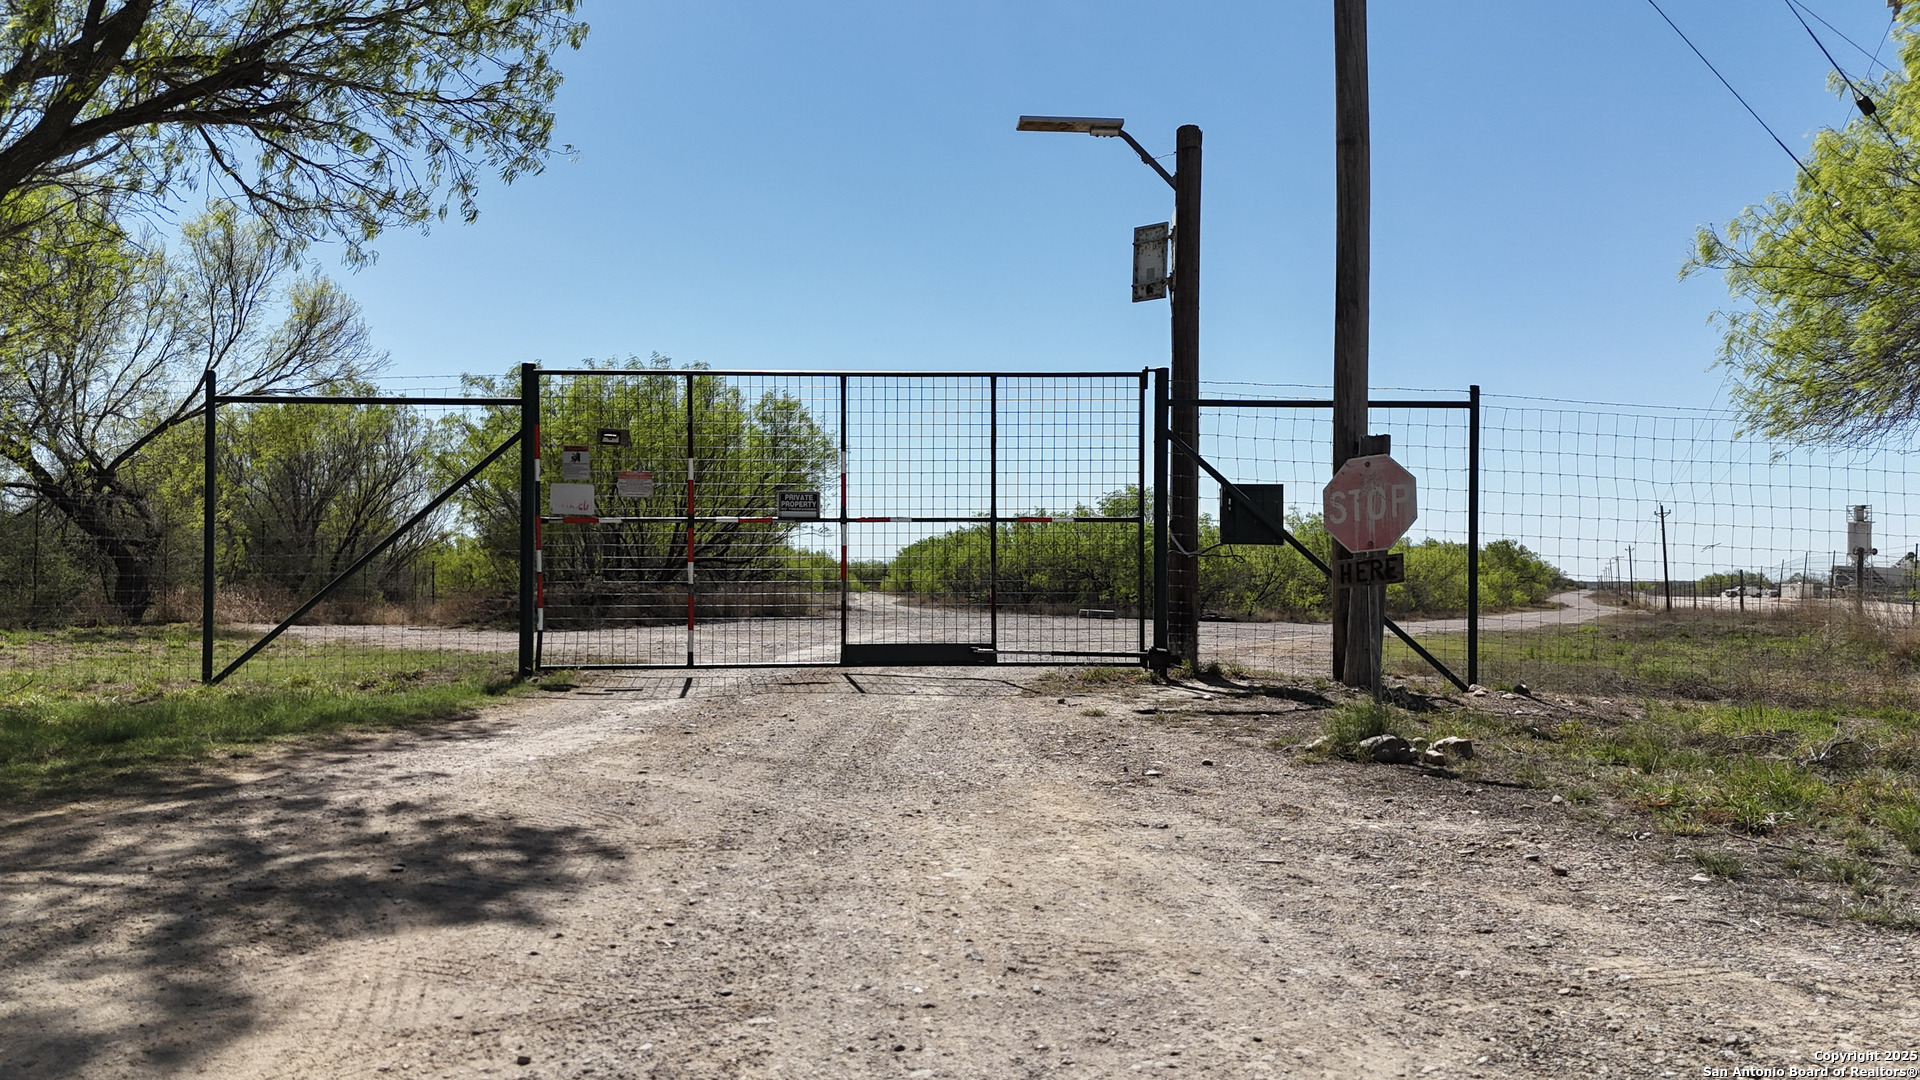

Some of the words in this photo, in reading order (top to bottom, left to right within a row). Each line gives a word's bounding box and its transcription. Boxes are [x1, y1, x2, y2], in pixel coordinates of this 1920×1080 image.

[781, 500, 817, 508] PROPERTY
[1329, 484, 1410, 525] STOP
[1340, 557, 1398, 585] HERE
